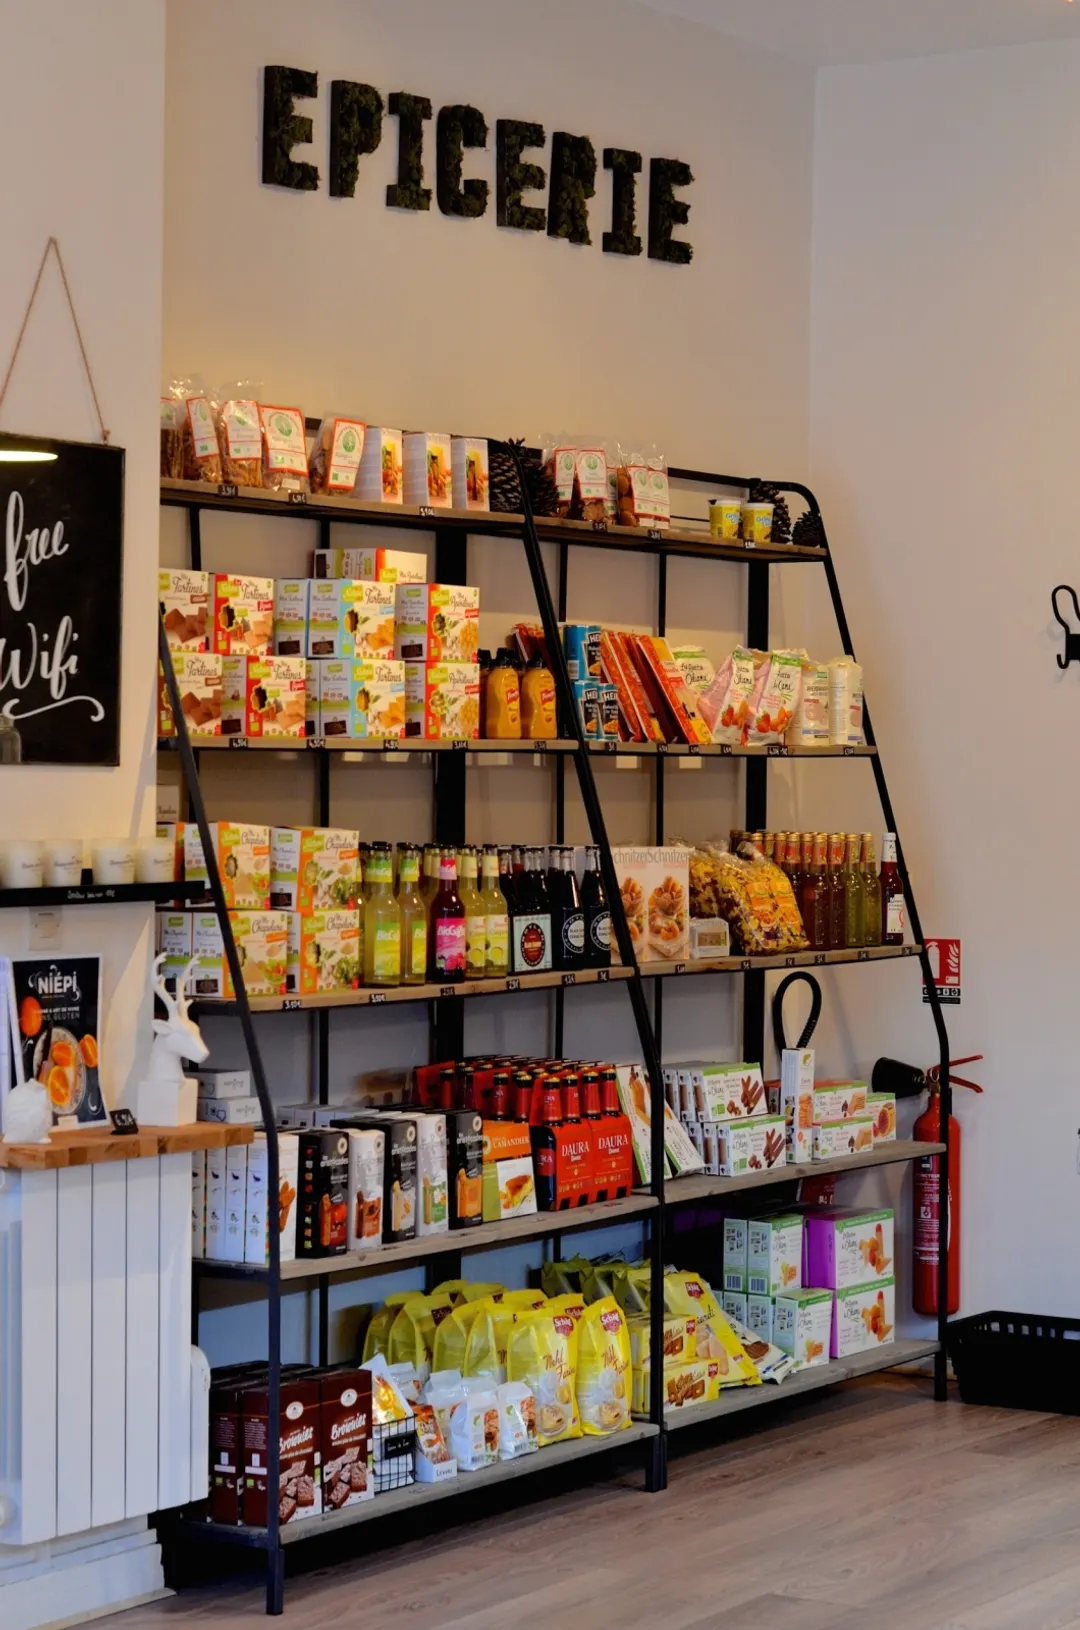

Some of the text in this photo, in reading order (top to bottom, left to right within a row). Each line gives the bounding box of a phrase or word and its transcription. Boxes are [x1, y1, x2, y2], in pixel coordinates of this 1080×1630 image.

[261, 65, 695, 264] EPICERIE
[4, 491, 69, 611] free
[0, 615, 79, 700] Wifi
[603, 691, 617, 702] HEI
[53, 1012, 80, 1020] GLUTEN
[562, 1141, 590, 1157] DAURA
[598, 1134, 628, 1149] DAURA
[331, 1412, 366, 1440] Brownies
